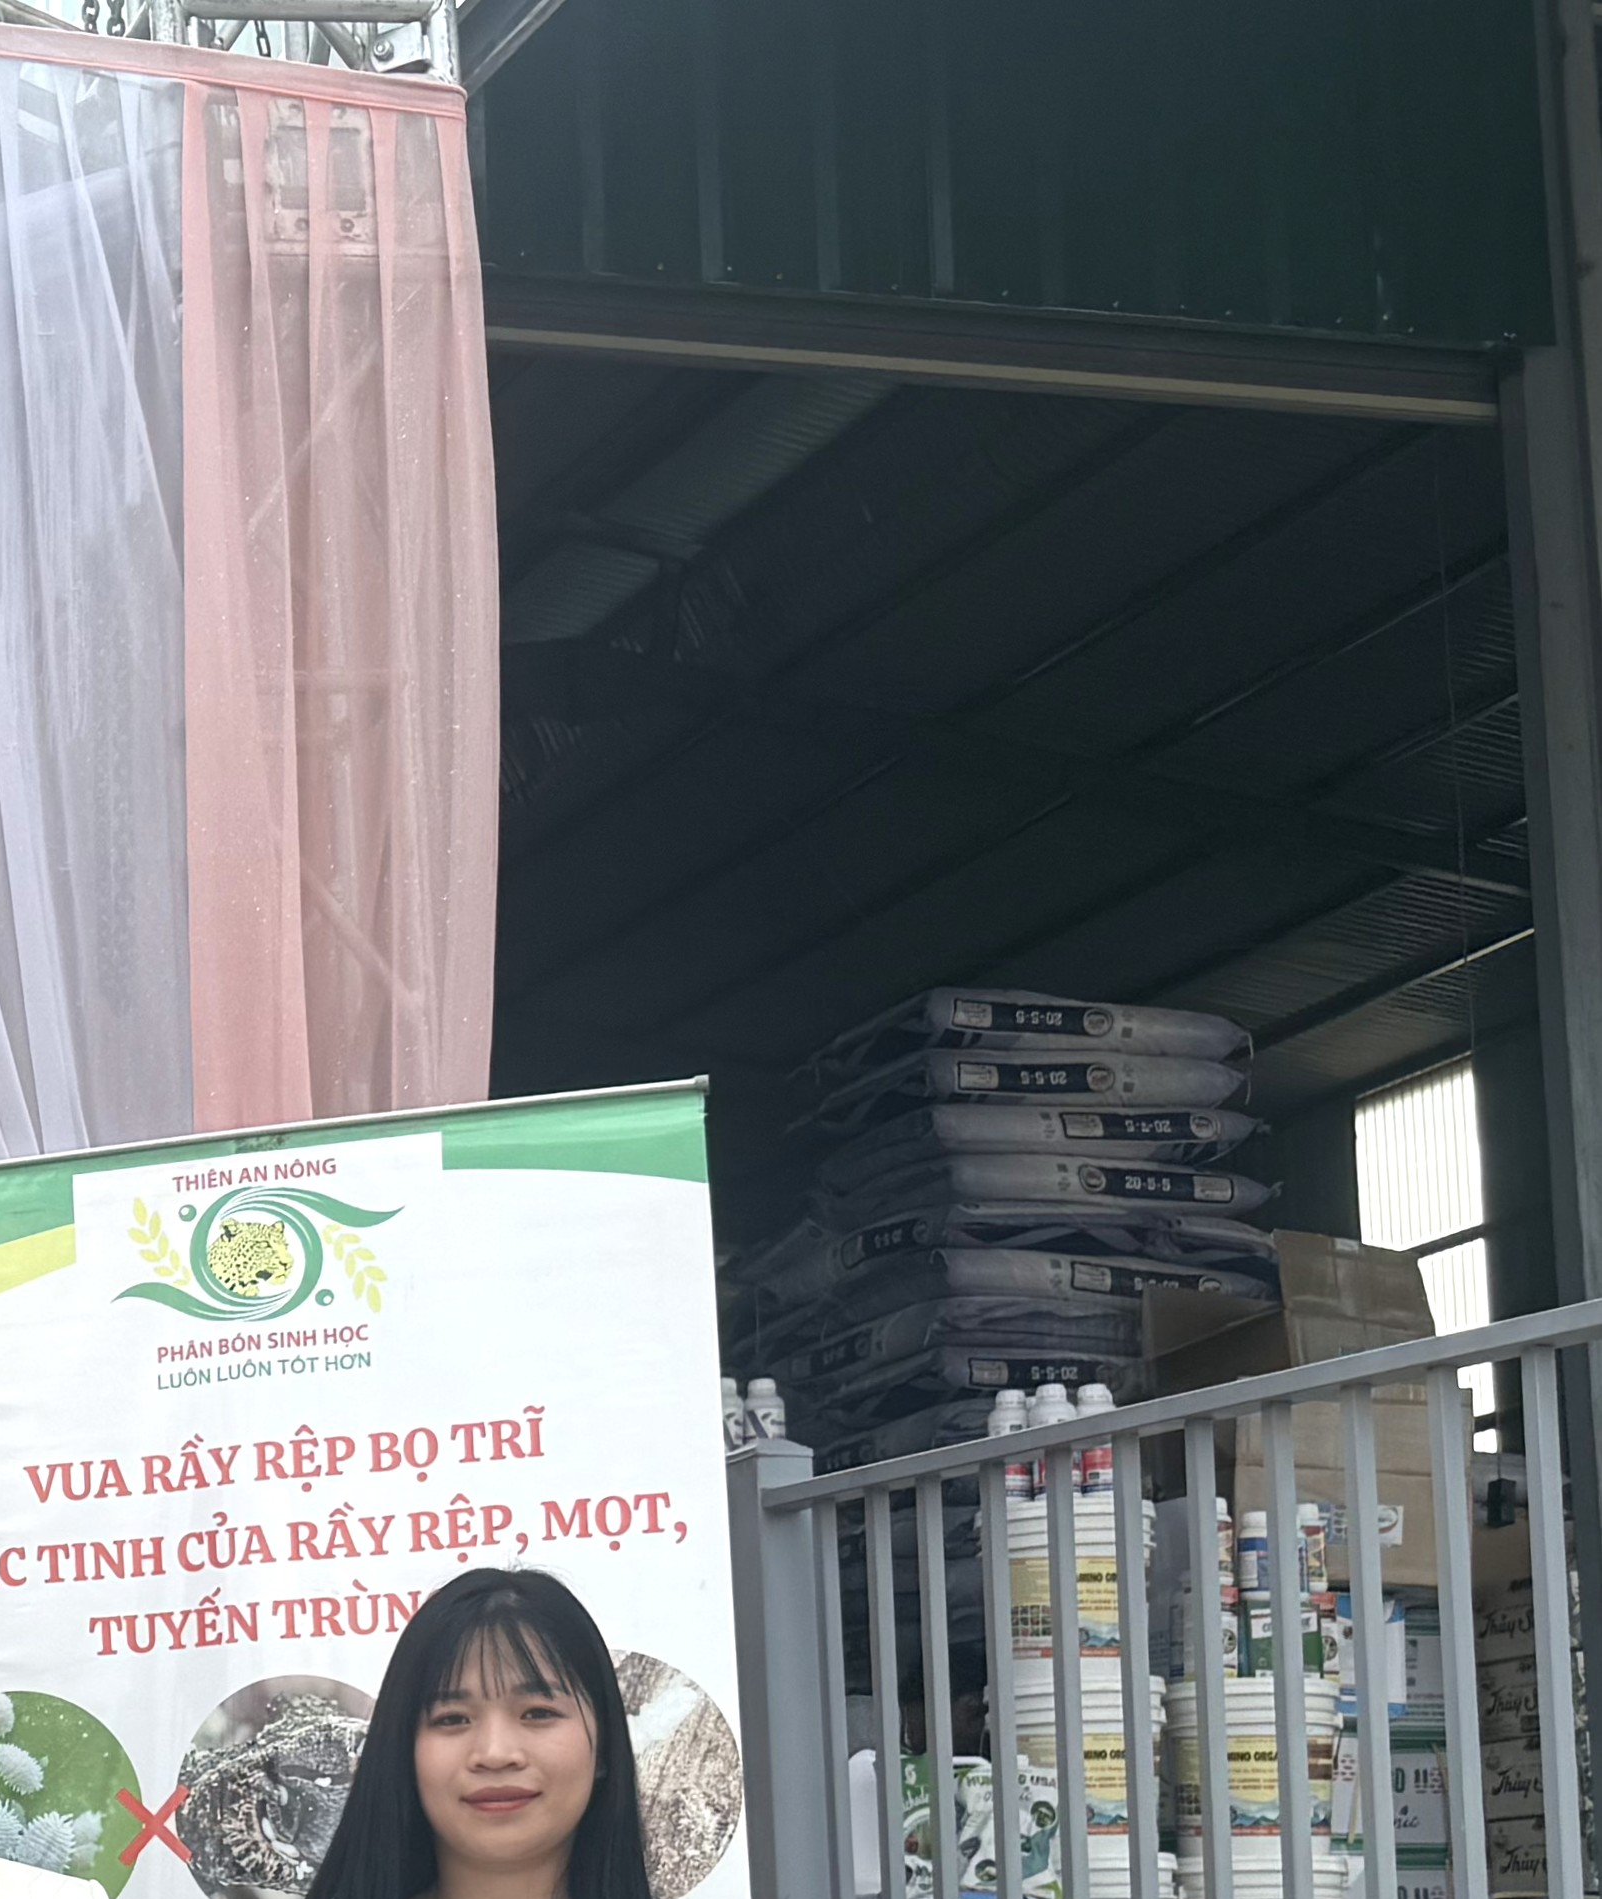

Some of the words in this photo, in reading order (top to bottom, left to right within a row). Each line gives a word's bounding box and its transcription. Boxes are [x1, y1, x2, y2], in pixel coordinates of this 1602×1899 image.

[173, 1169, 232, 1192] THIÊN
[239, 1166, 268, 1183] AN
[274, 1158, 336, 1179] NÔNG
[1125, 1175, 1171, 1192] 20-5-5
[158, 1340, 213, 1363] PHÂN
[218, 1333, 261, 1355] BÓN
[268, 1329, 317, 1349] SINH
[324, 1324, 369, 1348] HỌC
[24, 1459, 132, 1503] VUA
[142, 1433, 241, 1495] RẦY
[253, 1424, 355, 1492] RỆP
[368, 1427, 438, 1482] BỌ
[451, 1405, 545, 1463] TRĨ
[37, 1536, 165, 1583] TINH
[177, 1512, 276, 1572] CỦA
[287, 1502, 395, 1562] RẦY
[408, 1494, 528, 1563] RỆP,
[541, 1492, 687, 1552] MỌT,
[89, 1587, 259, 1655] TUYẾN
[272, 1579, 429, 1639] TRÙN
